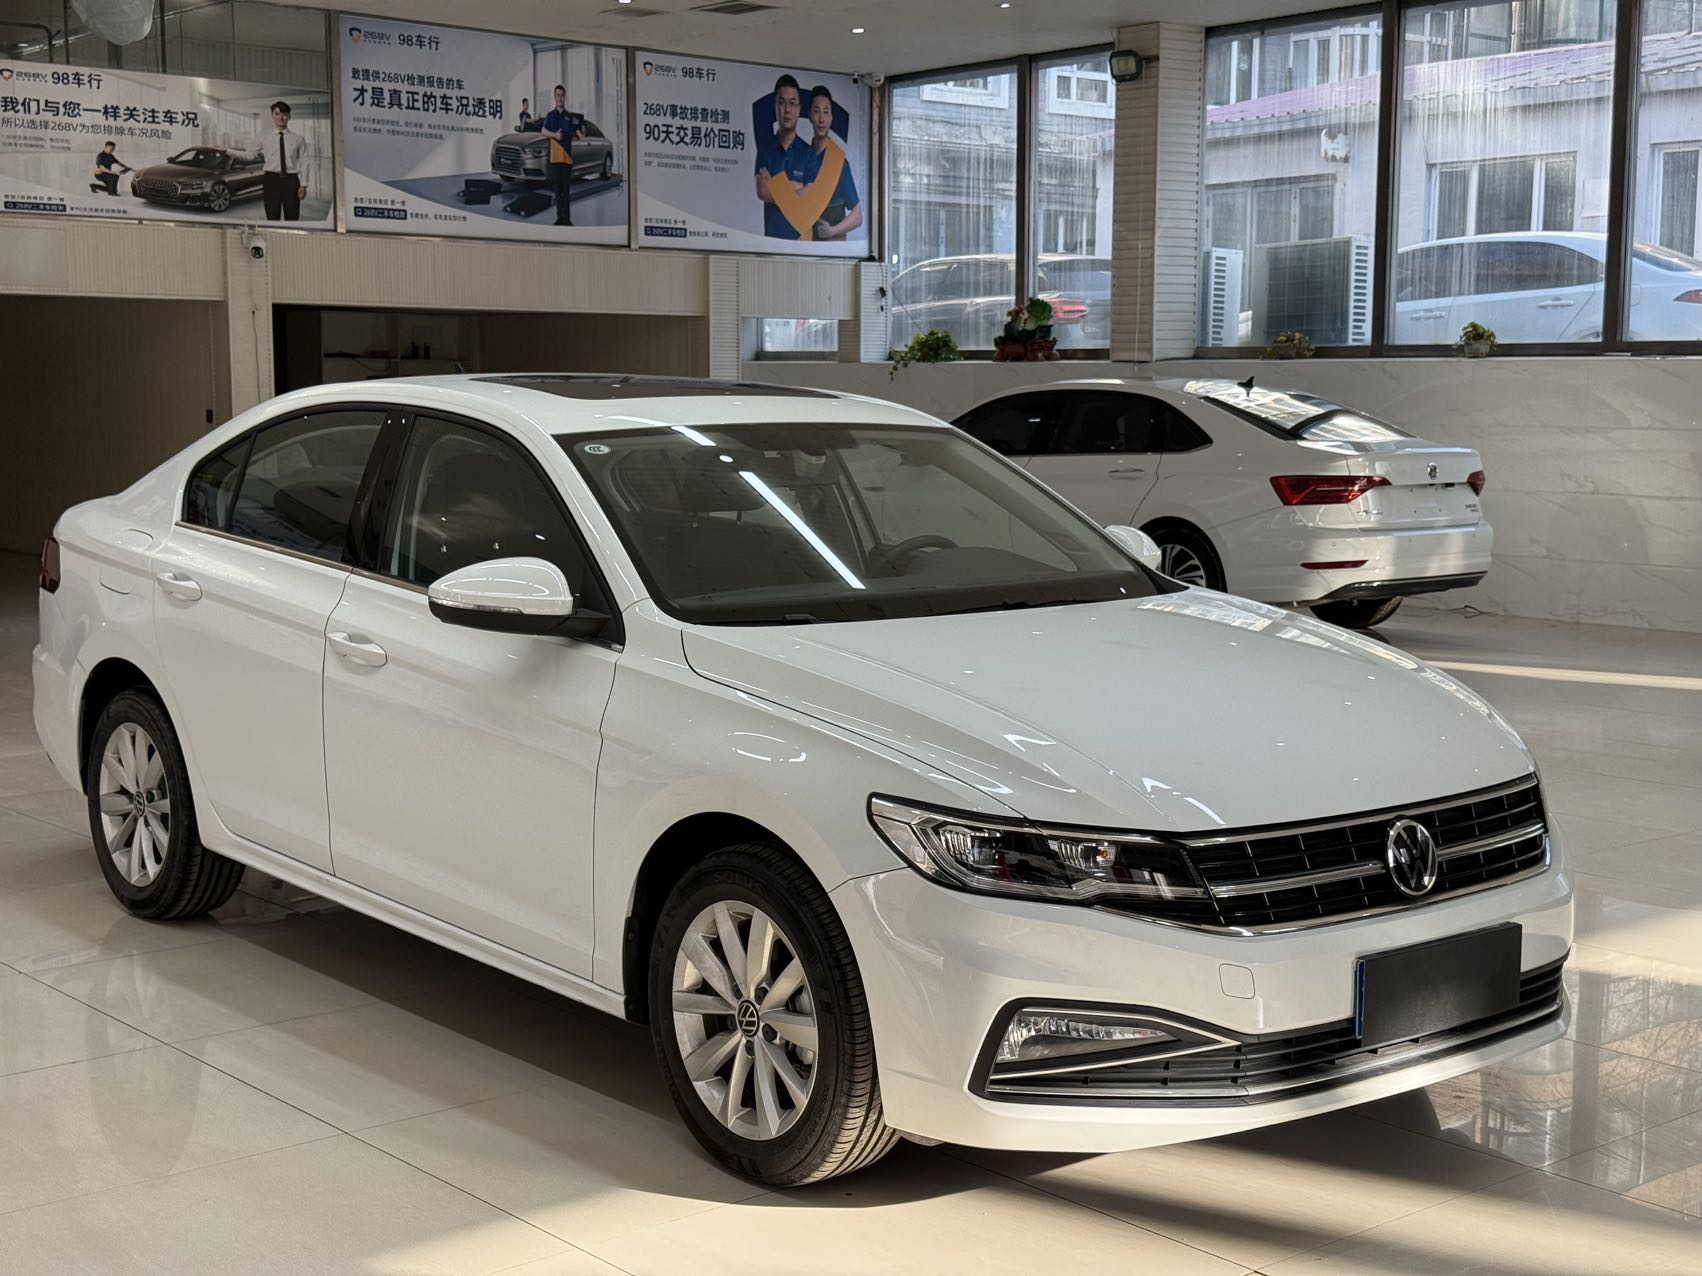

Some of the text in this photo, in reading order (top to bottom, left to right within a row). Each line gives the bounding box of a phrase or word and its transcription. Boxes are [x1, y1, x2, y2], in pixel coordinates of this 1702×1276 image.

[363, 30, 392, 41] 268V
[398, 33, 441, 51] 98车行
[16, 71, 48, 80] 268V
[51, 71, 103, 90] 98车行
[351, 67, 465, 91] 敢提供268V检测报告的车
[654, 64, 677, 73] 268V
[681, 66, 717, 82] 98车行
[1, 96, 200, 128] 我们与您一样关注车况
[352, 84, 504, 121] 才是真正的车况透明
[643, 102, 730, 125] 268V事故排查检测
[1, 117, 173, 141] 所以选择268V为您排除车况风险
[643, 123, 745, 151] 90天交易价回购
